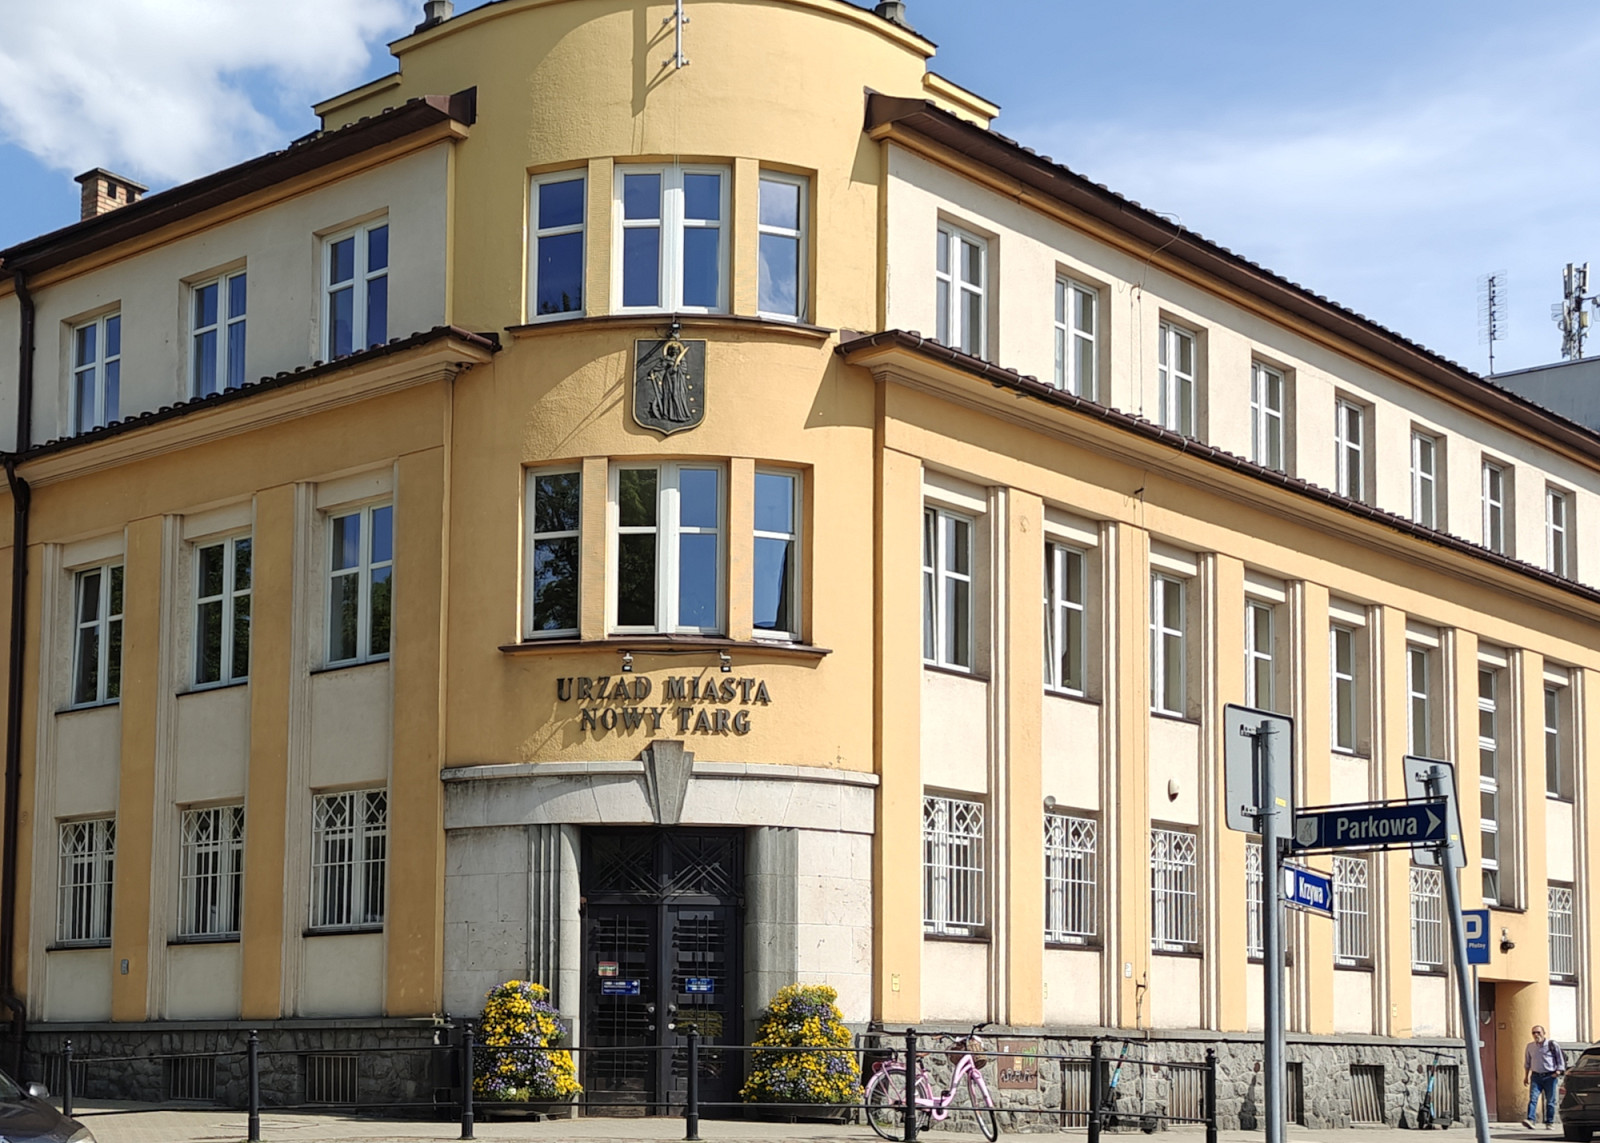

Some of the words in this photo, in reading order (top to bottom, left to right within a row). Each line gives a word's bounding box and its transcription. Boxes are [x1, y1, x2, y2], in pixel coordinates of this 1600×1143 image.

[667, 676, 772, 703] MIASTA
[580, 707, 666, 731] NOWY
[677, 707, 751, 733] TARG
[1336, 815, 1418, 840] Parkowa
[1299, 876, 1323, 905] Krzywa
